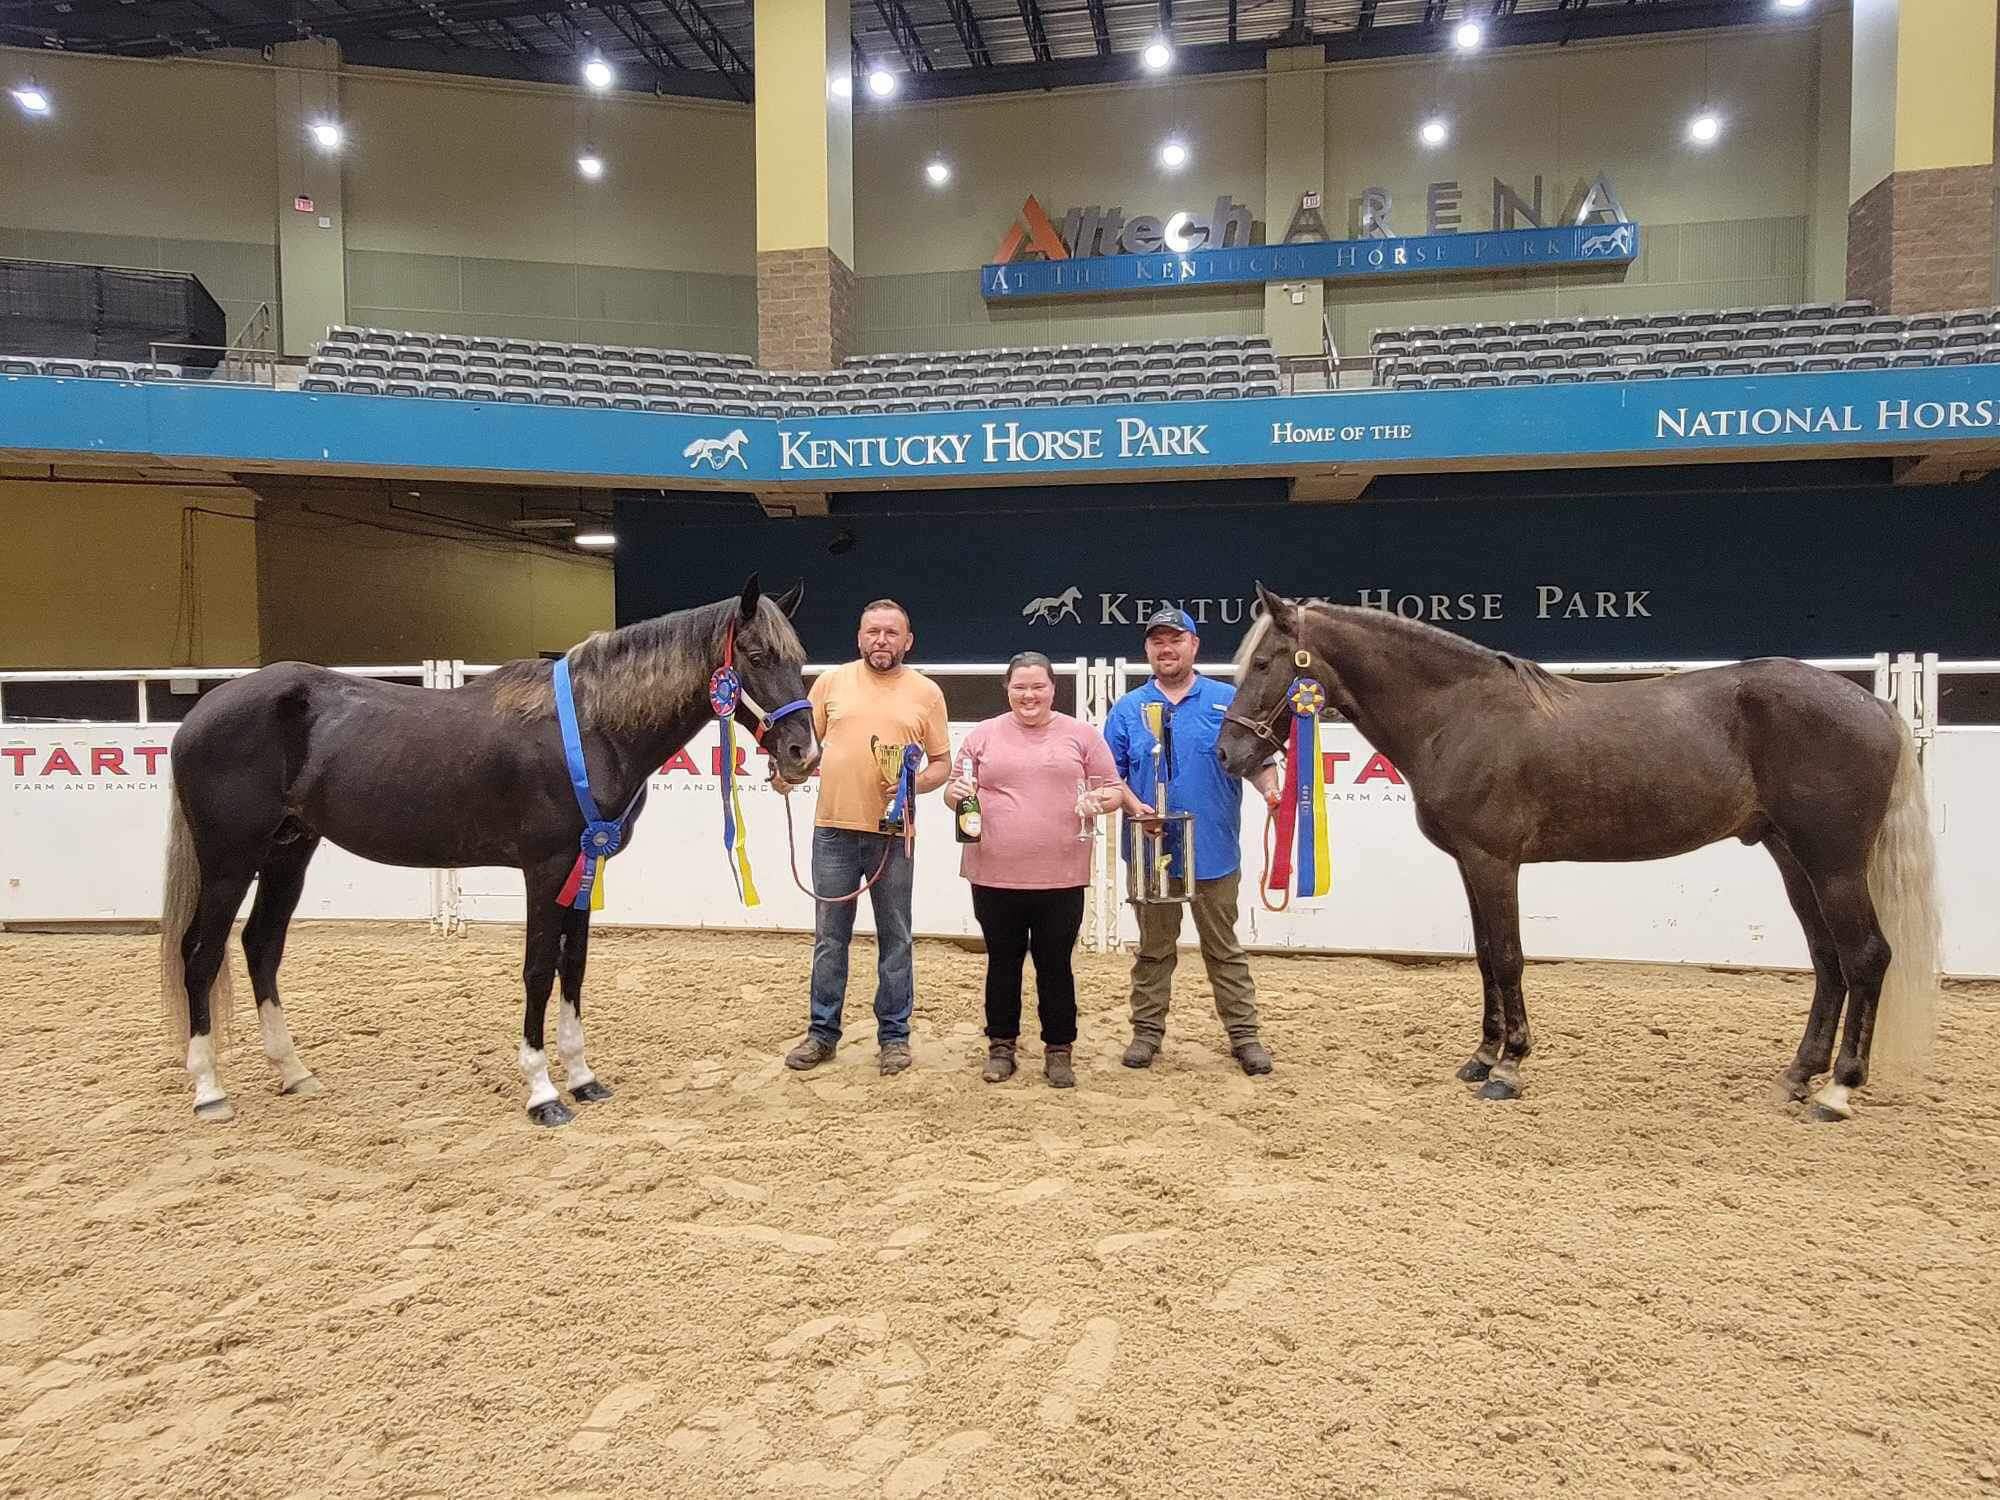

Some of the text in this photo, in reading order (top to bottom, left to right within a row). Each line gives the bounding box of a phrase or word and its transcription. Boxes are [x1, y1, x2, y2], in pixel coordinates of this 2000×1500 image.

[1283, 173, 1629, 244] ARENA
[993, 193, 1252, 263] Alltech
[991, 266, 1026, 291] AT
[1136, 257, 1308, 281] KENTUCKY
[1336, 245, 1447, 267] HORSE
[1475, 238, 1560, 259] PARK
[1272, 422, 1412, 444] HOME OF THE
[1655, 399, 2000, 438] NATIONAL HORS
[779, 417, 1209, 471] KENTUCKY HORSE PARK
[1357, 588, 1503, 621] HORSE
[1536, 585, 1652, 619] PARK
[14, 782, 158, 791] FARM AND RANCH
[683, 784, 715, 792] AND
[1384, 793, 1406, 801] AN
